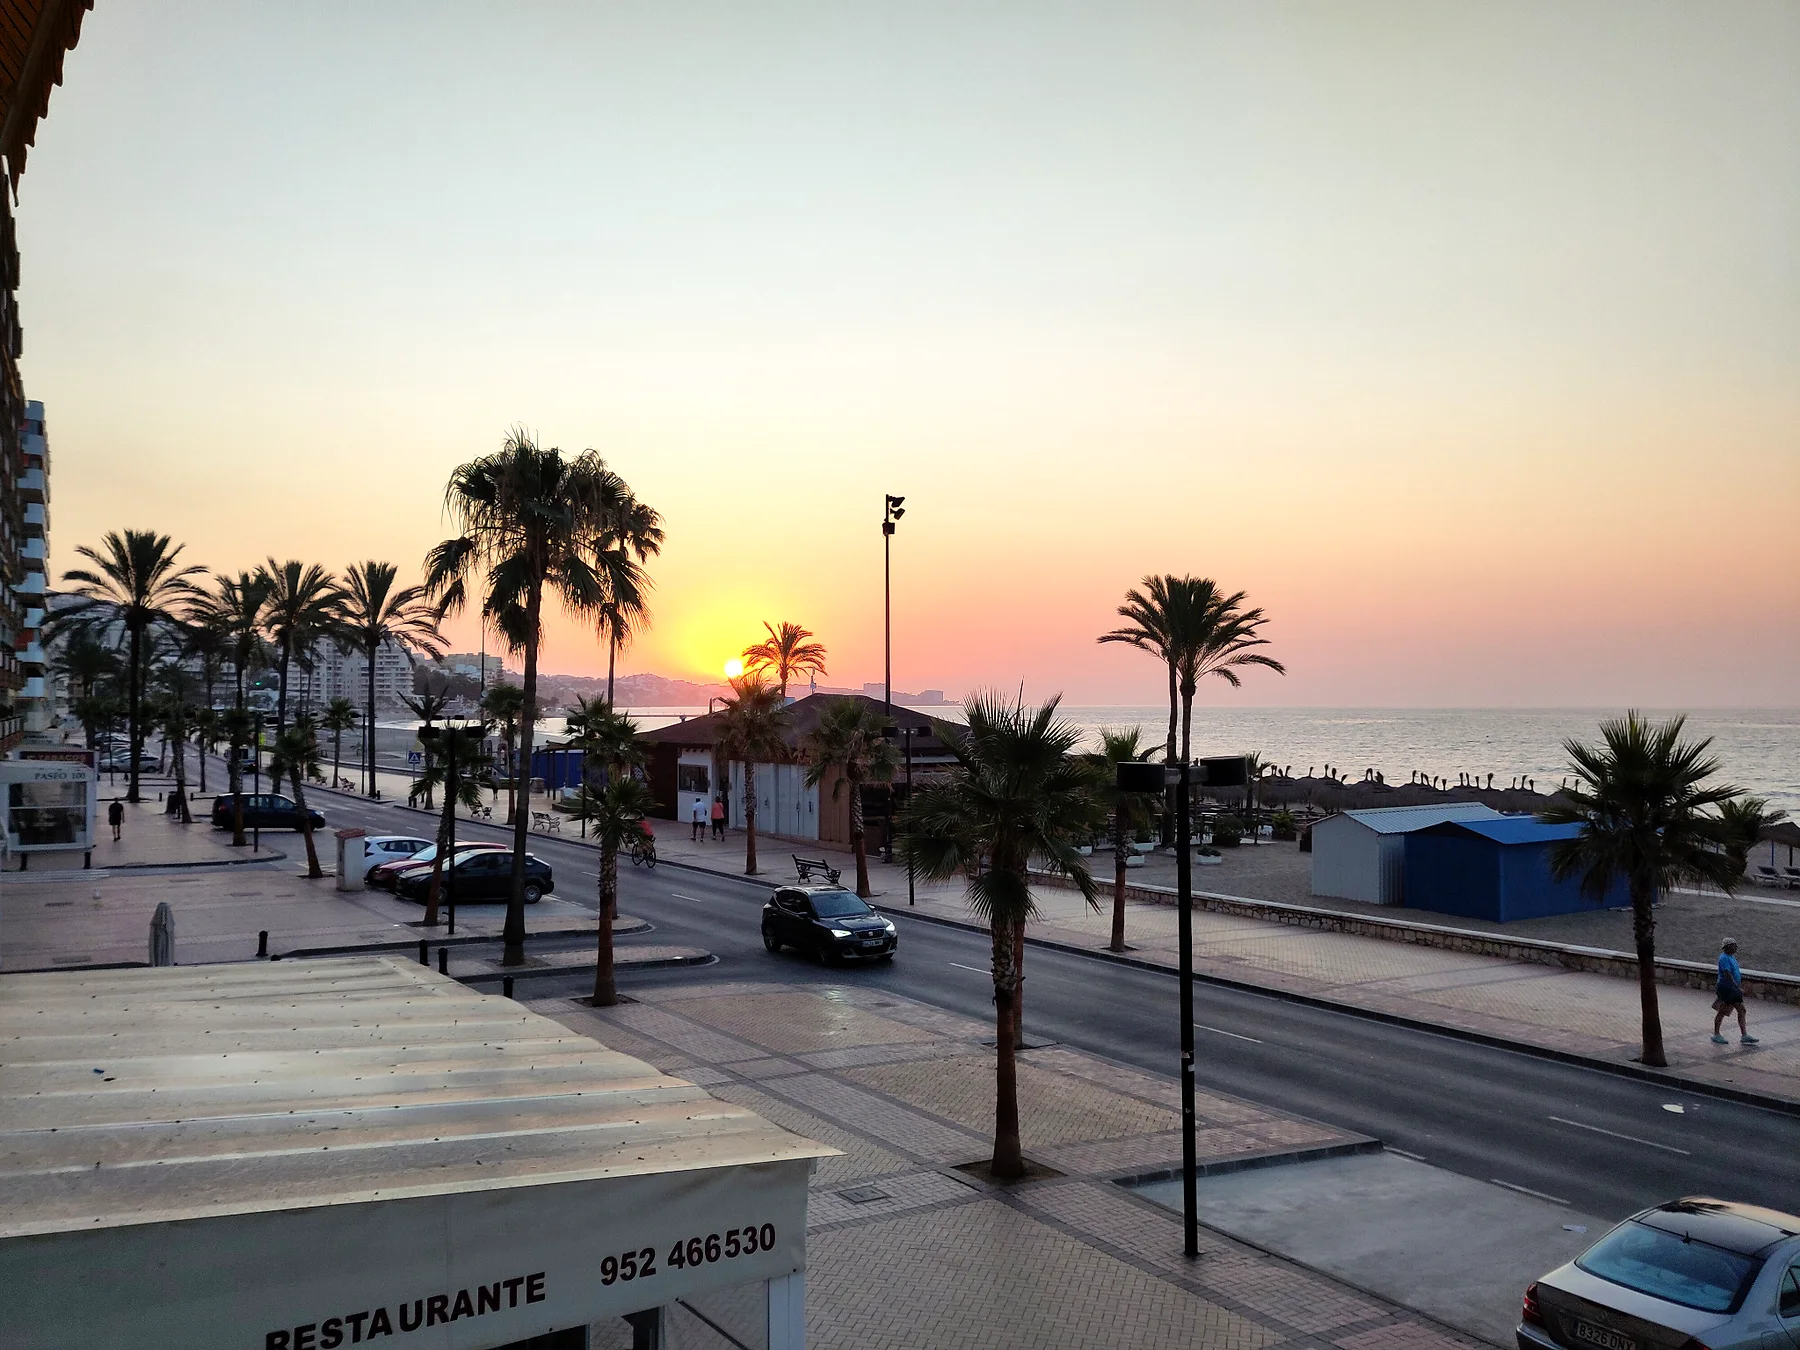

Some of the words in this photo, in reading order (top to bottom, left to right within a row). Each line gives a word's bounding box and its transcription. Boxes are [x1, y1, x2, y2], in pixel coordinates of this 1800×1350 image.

[34, 772, 67, 780] PASEO
[600, 1247, 656, 1286] 952
[667, 1223, 776, 1270] 466530
[265, 1272, 546, 1350] RESTAURANTE
